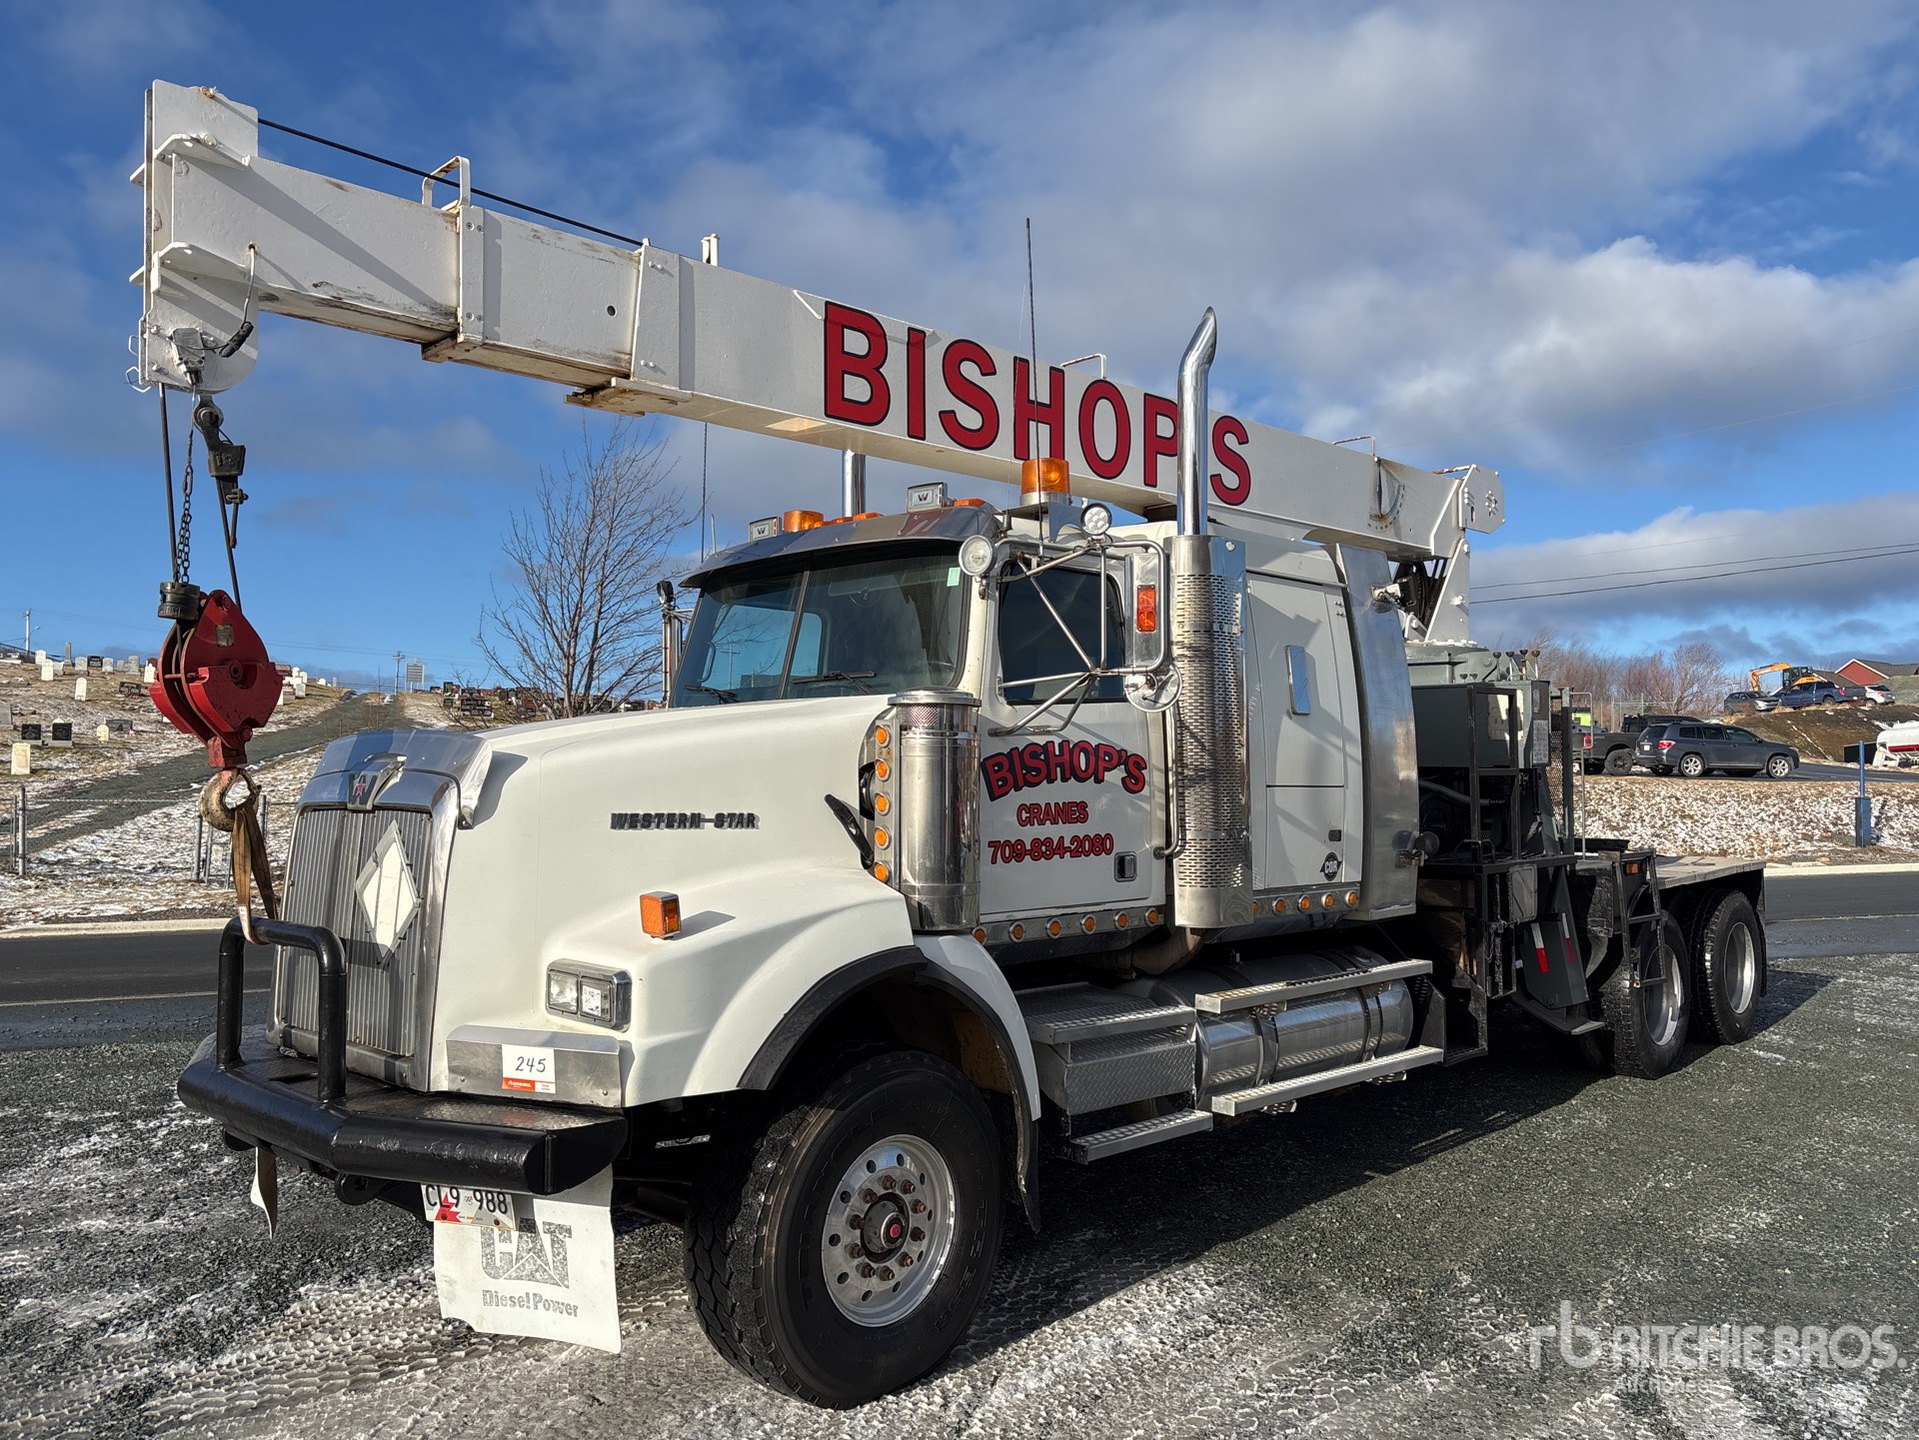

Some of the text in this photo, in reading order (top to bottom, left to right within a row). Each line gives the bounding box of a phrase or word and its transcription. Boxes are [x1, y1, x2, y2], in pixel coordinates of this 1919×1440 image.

[824, 300, 1252, 507] BISHOPS
[980, 740, 1147, 802] BISHOP'S
[610, 812, 760, 830] WESTERN STAR
[1016, 801, 1089, 827] CRANES
[988, 833, 1114, 864] 709-834-2080
[515, 1056, 546, 1073] 245
[426, 1184, 460, 1209] CL9
[473, 1189, 508, 1215] 988
[480, 1218, 572, 1289] CAT
[482, 1289, 578, 1317] Diesel Power
